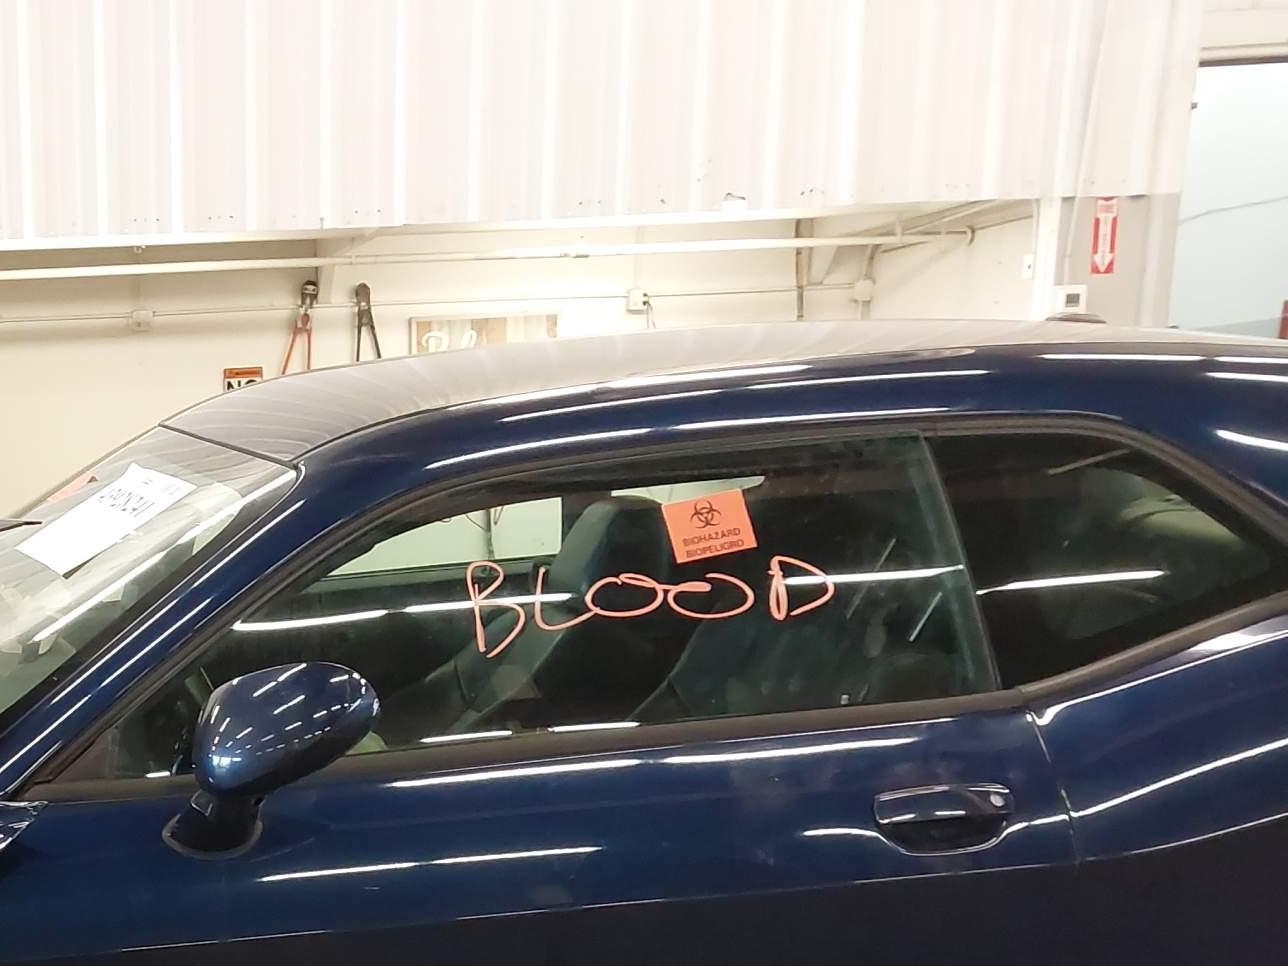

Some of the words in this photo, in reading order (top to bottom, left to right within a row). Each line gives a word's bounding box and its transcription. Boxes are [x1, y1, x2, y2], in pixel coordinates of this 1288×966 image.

[682, 528, 741, 547] BIOHAZARD
[686, 539, 745, 558] BIOPELIGRO
[466, 555, 835, 658] BLOOD
